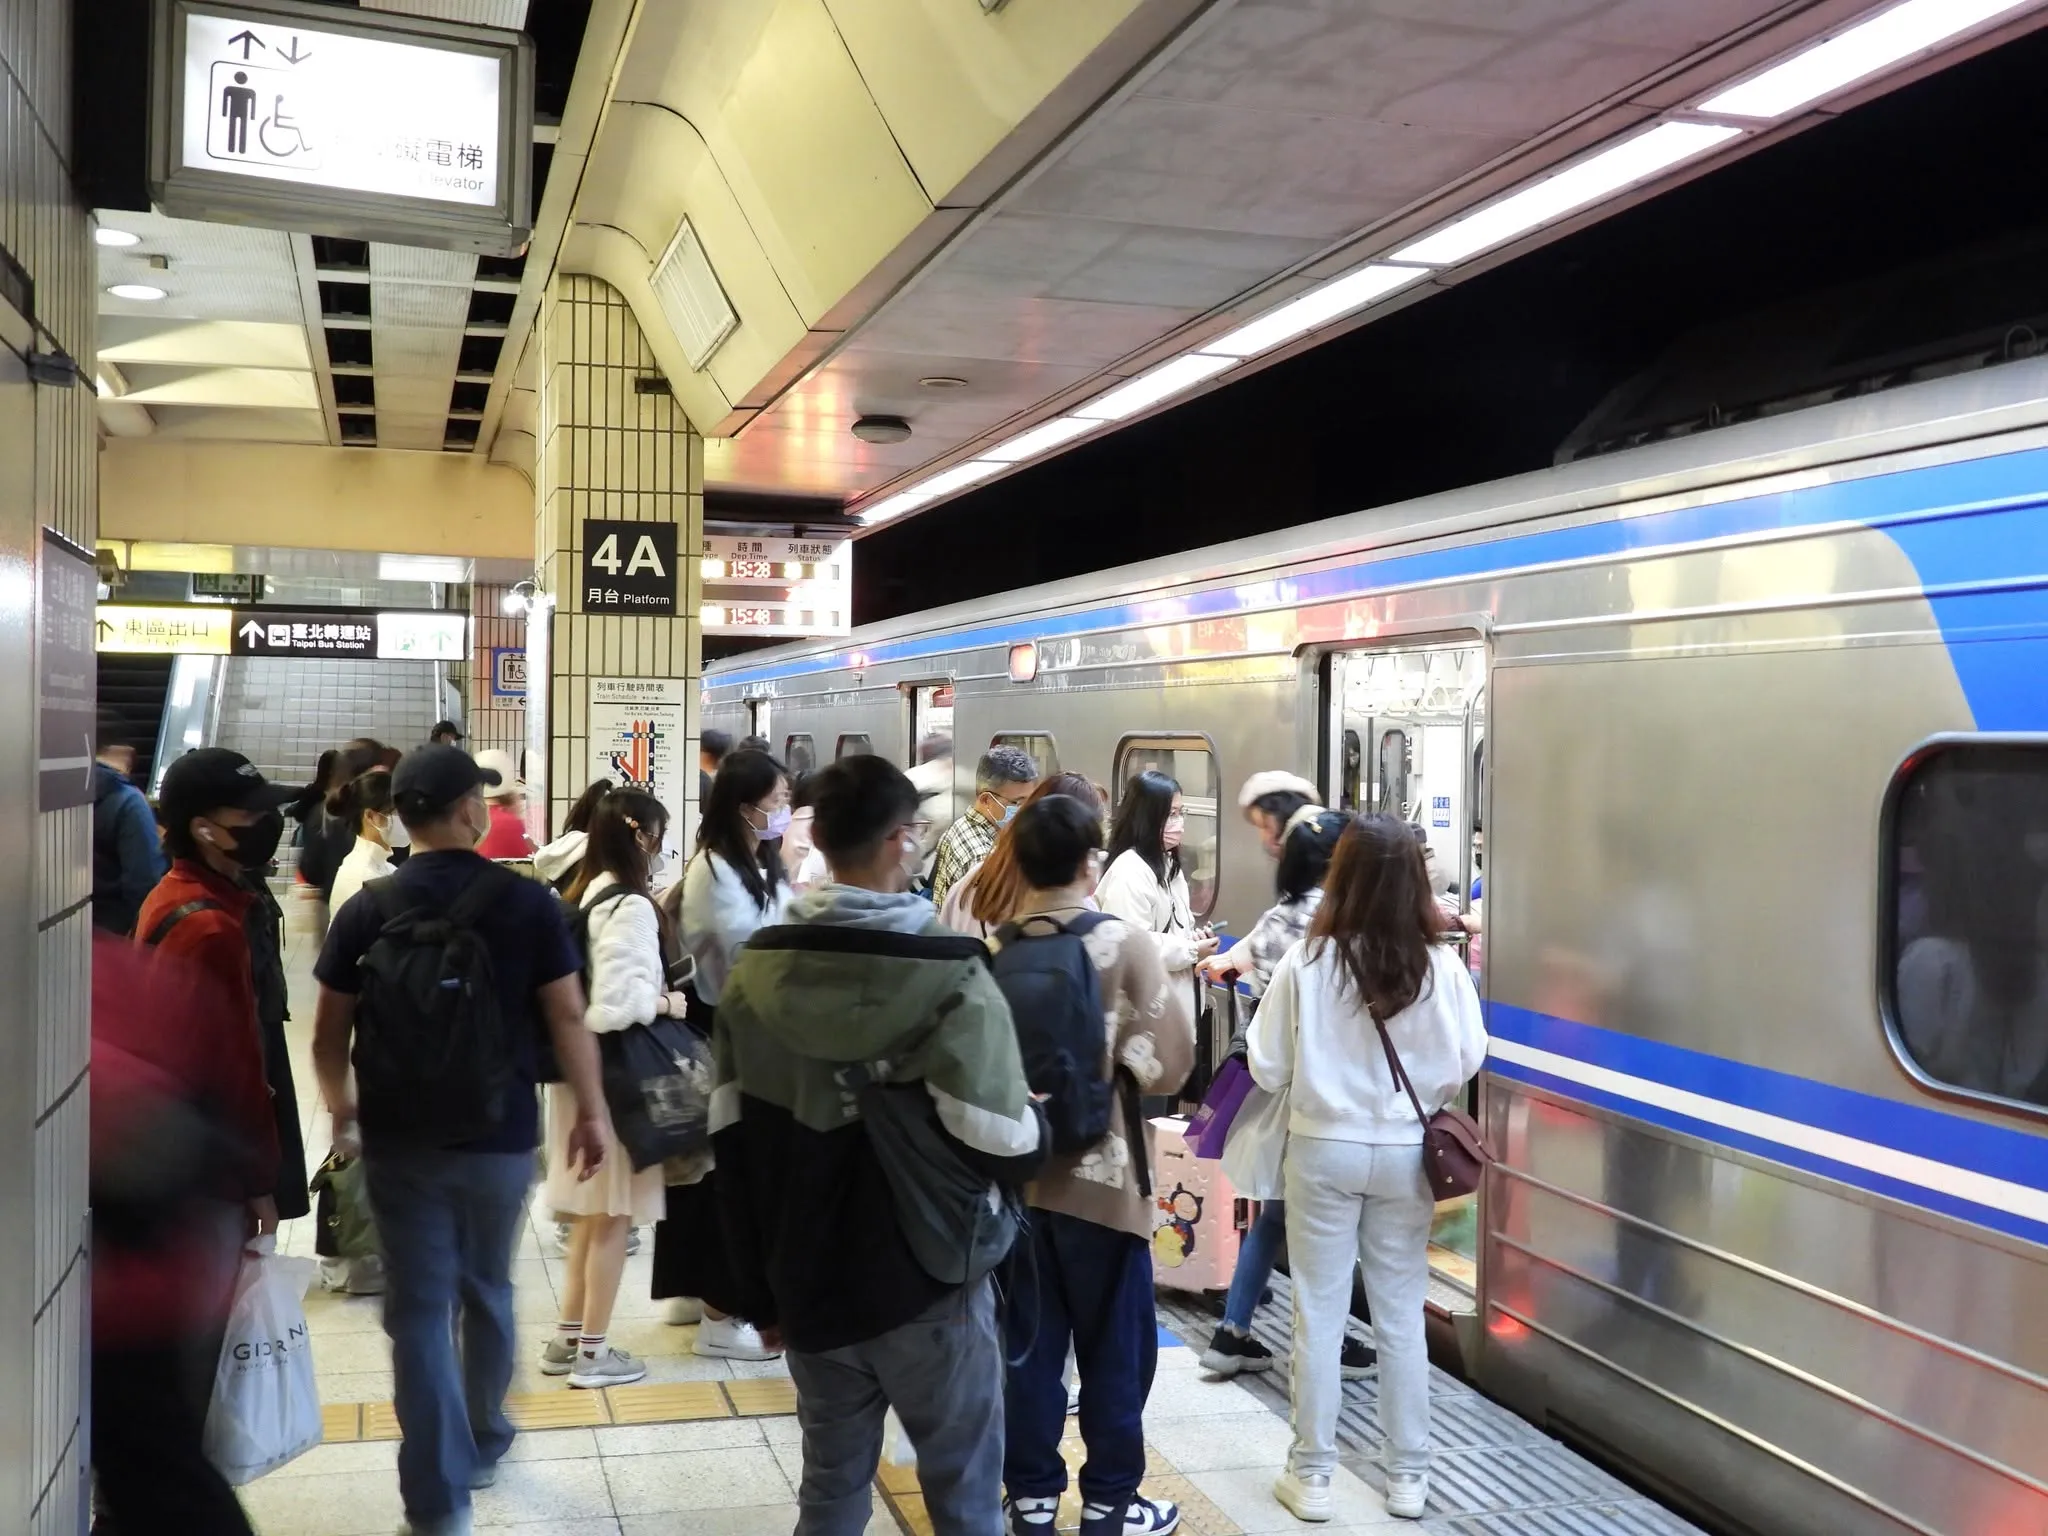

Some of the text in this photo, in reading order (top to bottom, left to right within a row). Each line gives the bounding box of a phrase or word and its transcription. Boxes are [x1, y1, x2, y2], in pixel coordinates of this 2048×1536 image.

[418, 171, 484, 192] levator
[592, 533, 666, 577] 4A
[737, 542, 763, 554] 時間
[788, 543, 833, 555] 列車狀態
[731, 561, 771, 578] 15:28
[587, 588, 670, 605] 月台 Platform
[731, 608, 771, 625] 15:48
[125, 618, 209, 637] 東區出口
[292, 640, 316, 649] Taipei
[336, 641, 365, 649] Station
